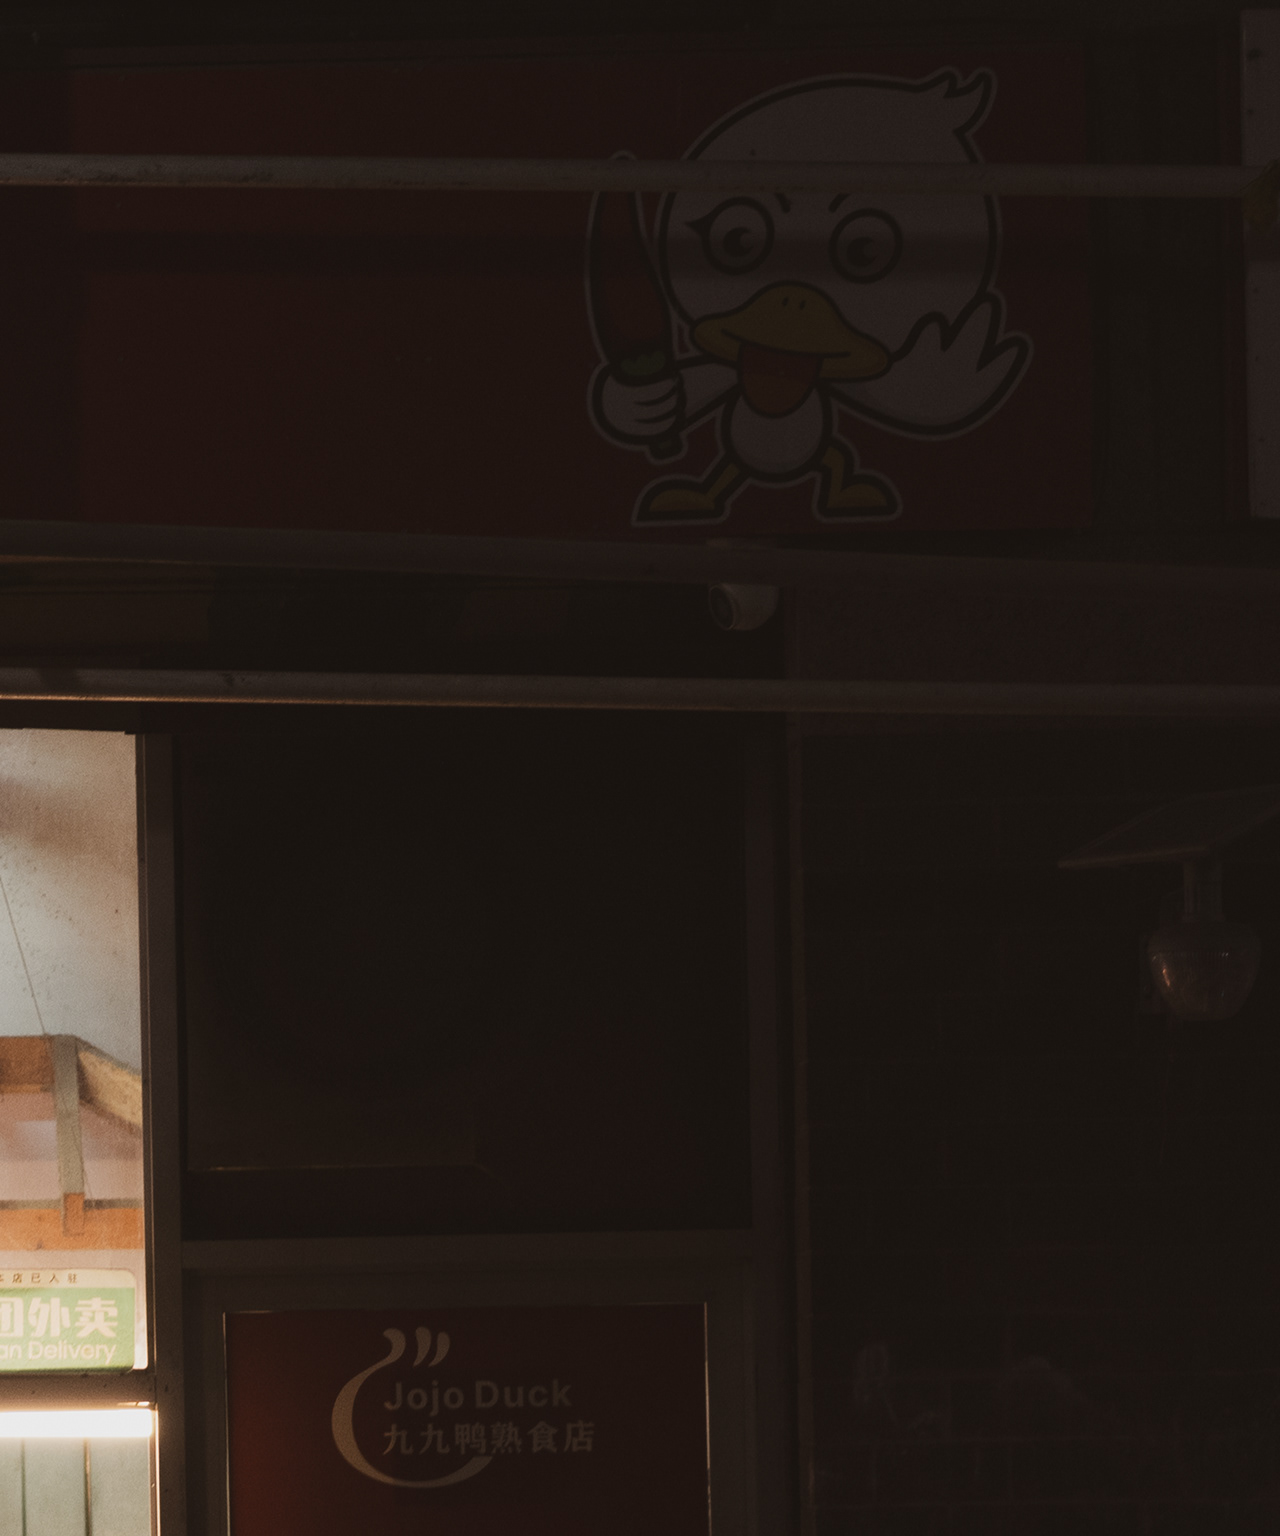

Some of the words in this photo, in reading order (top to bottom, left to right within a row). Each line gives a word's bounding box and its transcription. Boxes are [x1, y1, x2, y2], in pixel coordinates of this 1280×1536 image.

[28, 1340, 117, 1366] Delivery
[383, 1381, 465, 1417] Jojo
[474, 1378, 573, 1409] Duck
[382, 1420, 595, 1457] 九九鸭熟食店
